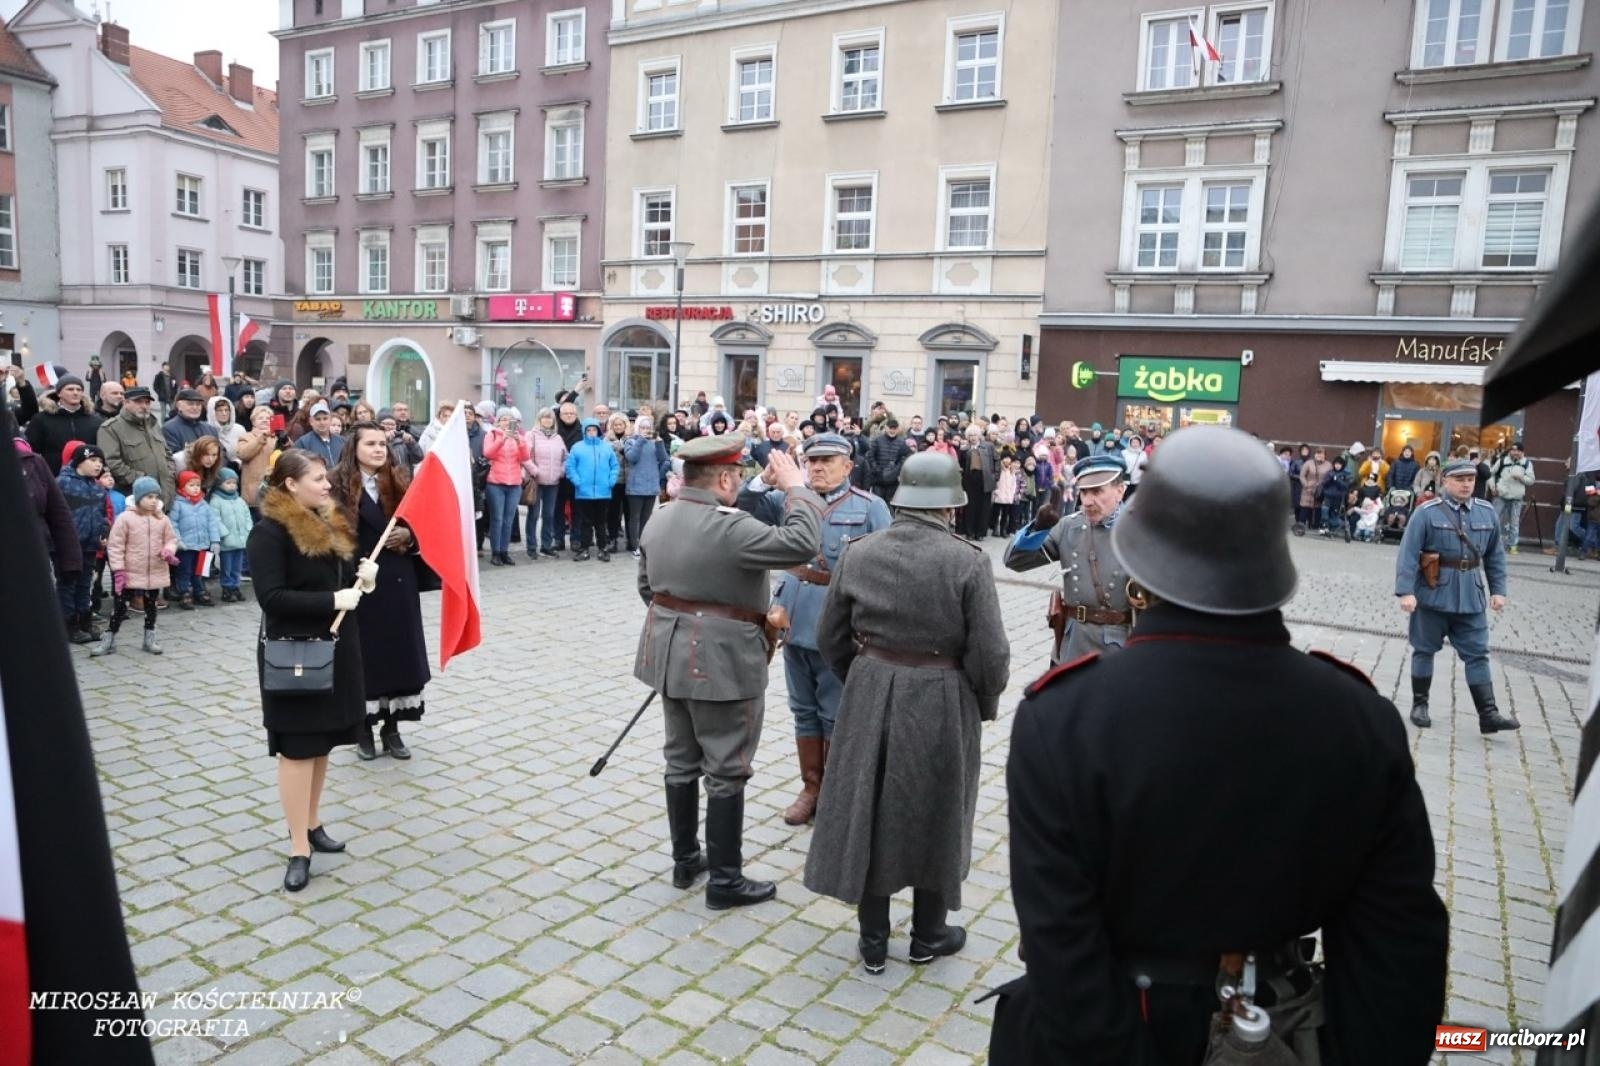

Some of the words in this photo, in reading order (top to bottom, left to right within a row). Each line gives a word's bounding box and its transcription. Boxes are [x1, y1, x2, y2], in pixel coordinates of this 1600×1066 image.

[363, 301, 437, 320] KANTOR
[762, 303, 824, 323] SHIRO
[1134, 365, 1223, 392] żabka
